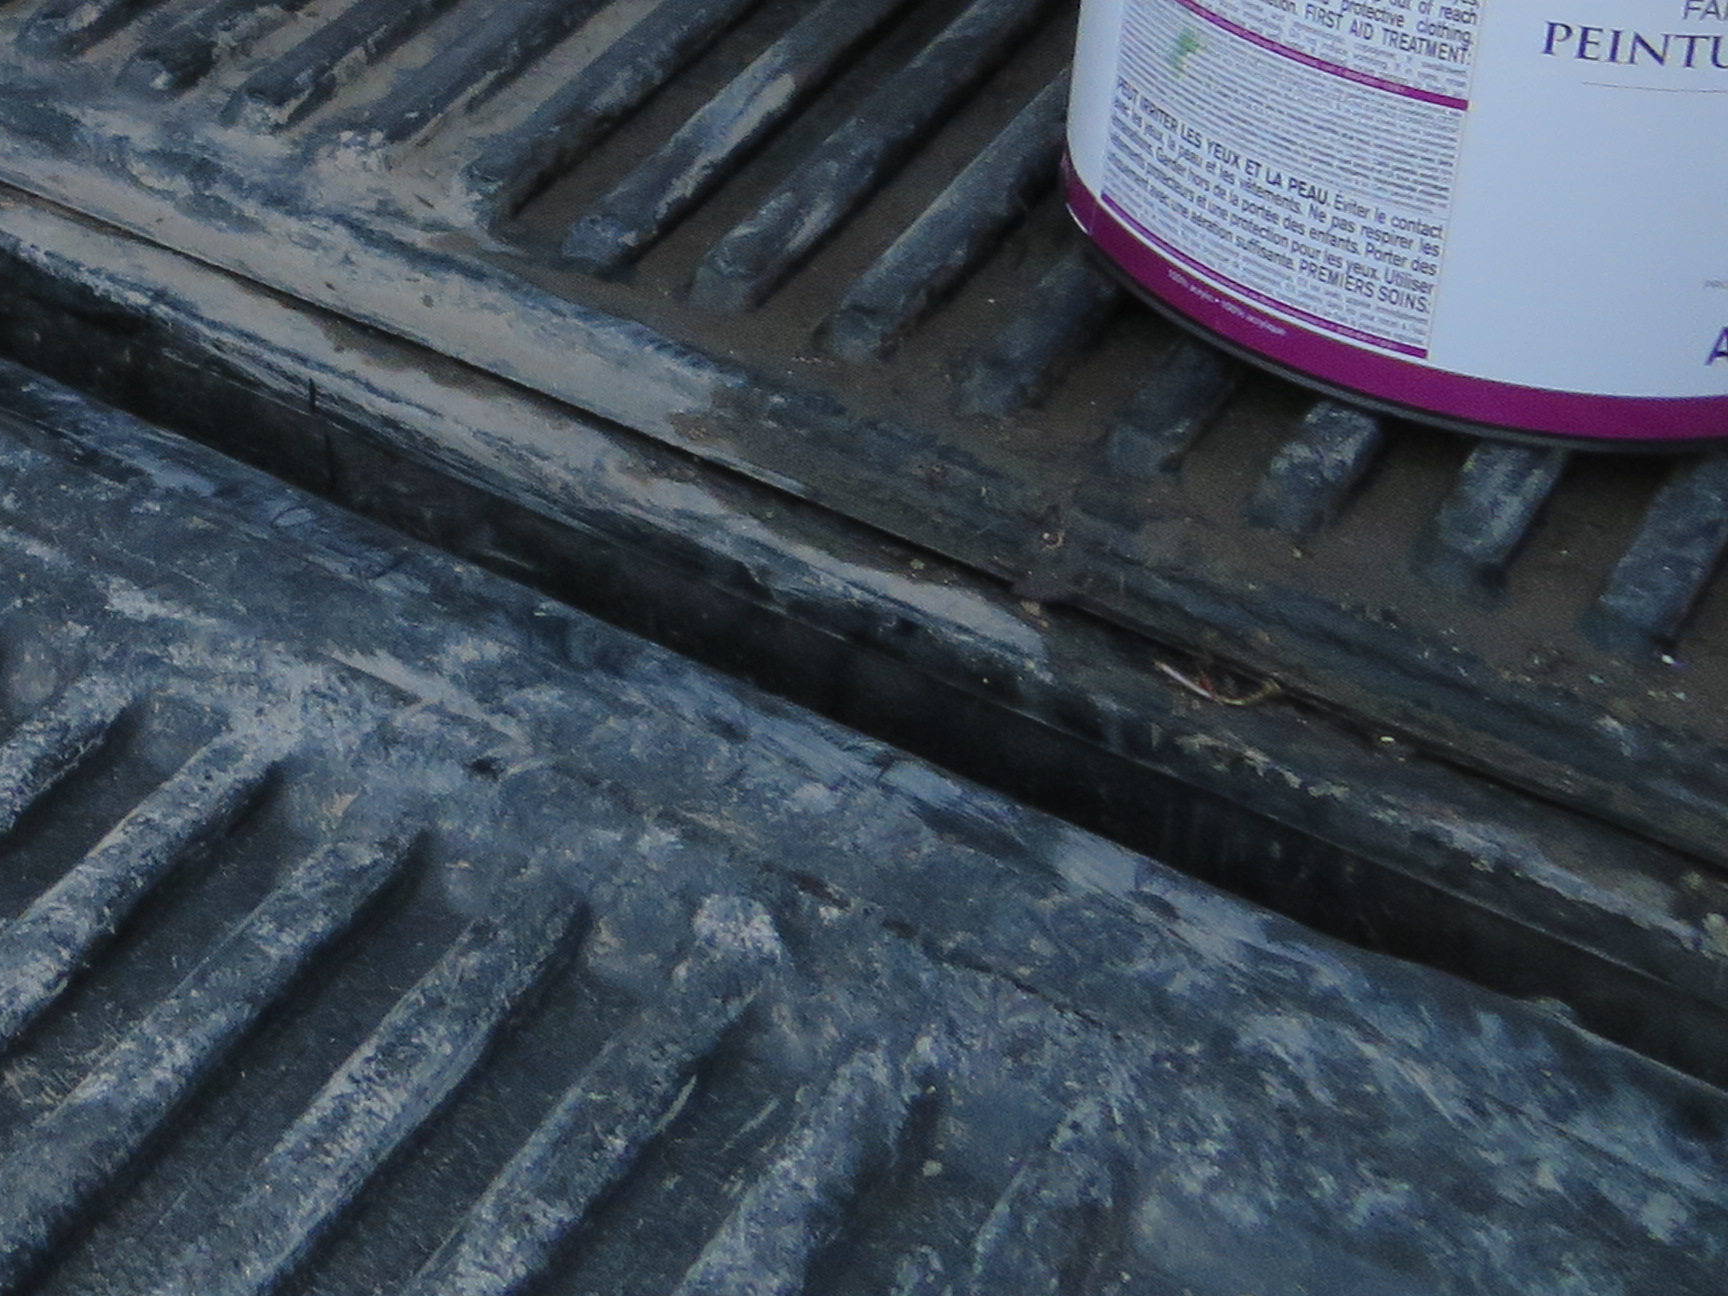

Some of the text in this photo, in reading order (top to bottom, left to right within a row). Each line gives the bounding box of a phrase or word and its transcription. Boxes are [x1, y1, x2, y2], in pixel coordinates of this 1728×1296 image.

[1305, 3, 1343, 30] FIRST
[1349, 19, 1374, 41] AID
[1382, 28, 1472, 67] TREATMENT:
[1416, 17, 1473, 47] clothing.
[1440, 5, 1478, 25] reach
[1541, 21, 1728, 70] PEINTU
[1180, 123, 1203, 149] LES
[1206, 137, 1241, 170] YEUX
[1244, 158, 1262, 178] ET
[1265, 167, 1282, 188] LA
[1287, 177, 1331, 207] PEAU.
[1374, 206, 1387, 225] le
[1390, 214, 1444, 240] contact
[1205, 161, 1217, 174] et
[1220, 165, 1235, 184] les
[1308, 203, 1327, 223] Ne
[1331, 214, 1355, 234] pas
[1360, 223, 1414, 251] respirer
[1420, 238, 1440, 257] les
[1188, 167, 1210, 192] hors
[1213, 184, 1227, 201] de
[1229, 189, 1239, 207] la
[1283, 214, 1306, 236] des
[1309, 226, 1361, 255] enfants.
[1364, 241, 1409, 268] Porter
[1410, 257, 1437, 277] des
[1230, 213, 1289, 249] protection
[1291, 240, 1321, 260] pour
[1324, 249, 1343, 269] les
[1345, 258, 1378, 280] yeux.
[1384, 267, 1434, 295] Utiliser
[1299, 259, 1374, 298] PREMIERS
[1377, 285, 1431, 314] SOINS:
